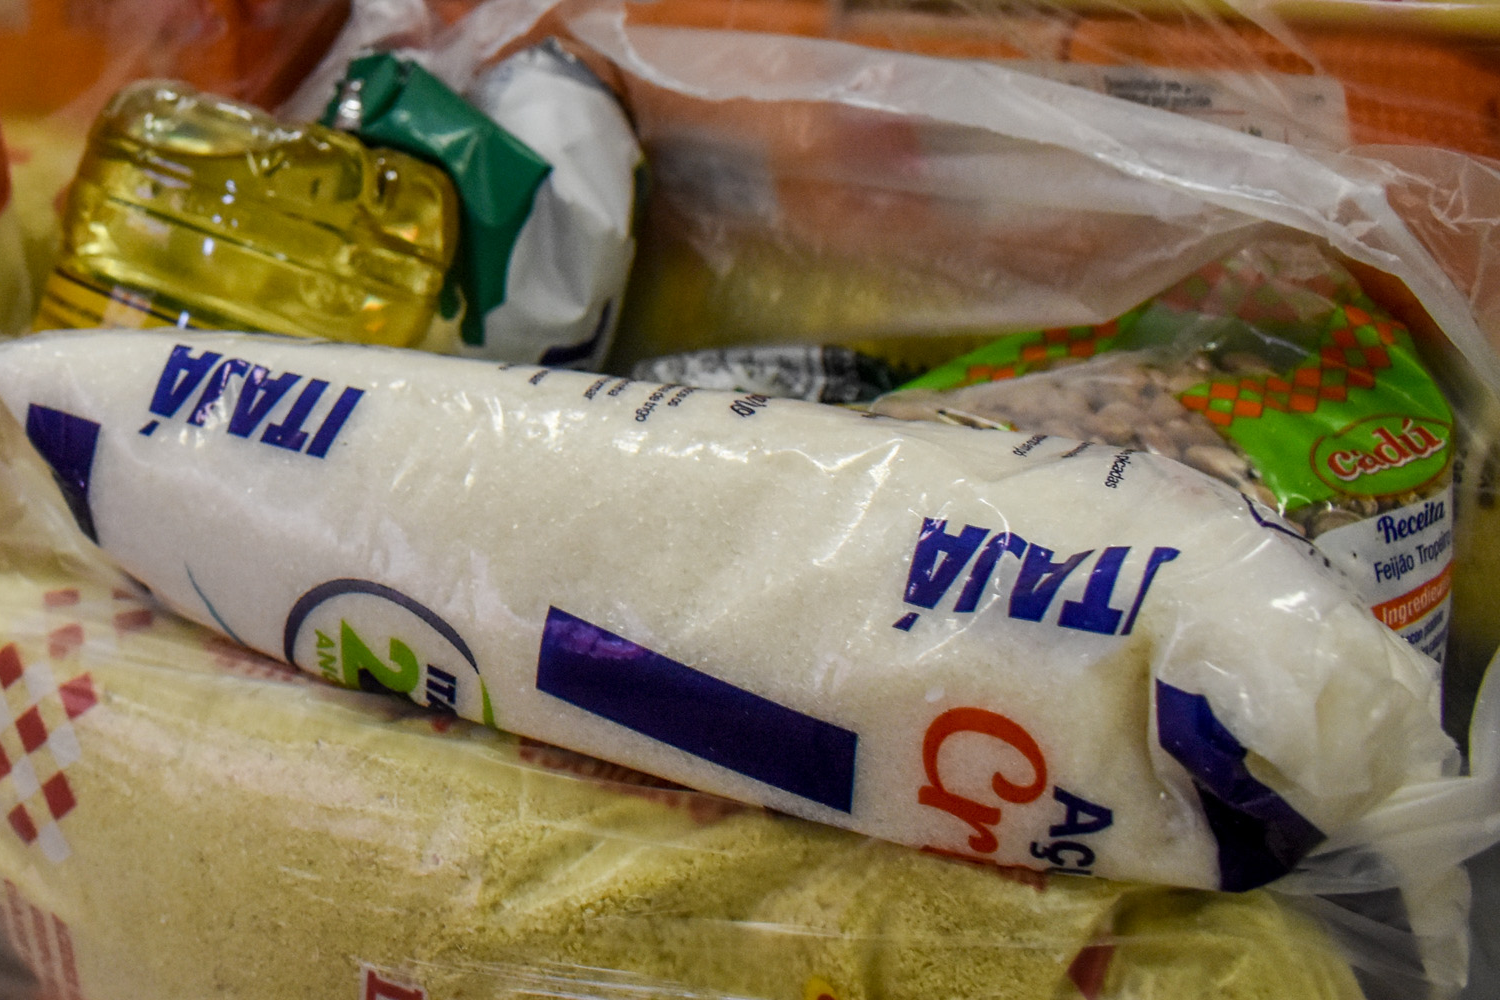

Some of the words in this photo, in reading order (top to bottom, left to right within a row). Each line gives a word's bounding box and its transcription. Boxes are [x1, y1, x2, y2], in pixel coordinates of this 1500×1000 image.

[139, 344, 366, 459] ITAJÁ
[1327, 417, 1446, 481] Cadú
[1104, 453, 1131, 489] picadas
[1377, 501, 1445, 544] Receita
[1374, 553, 1415, 583] Feijão
